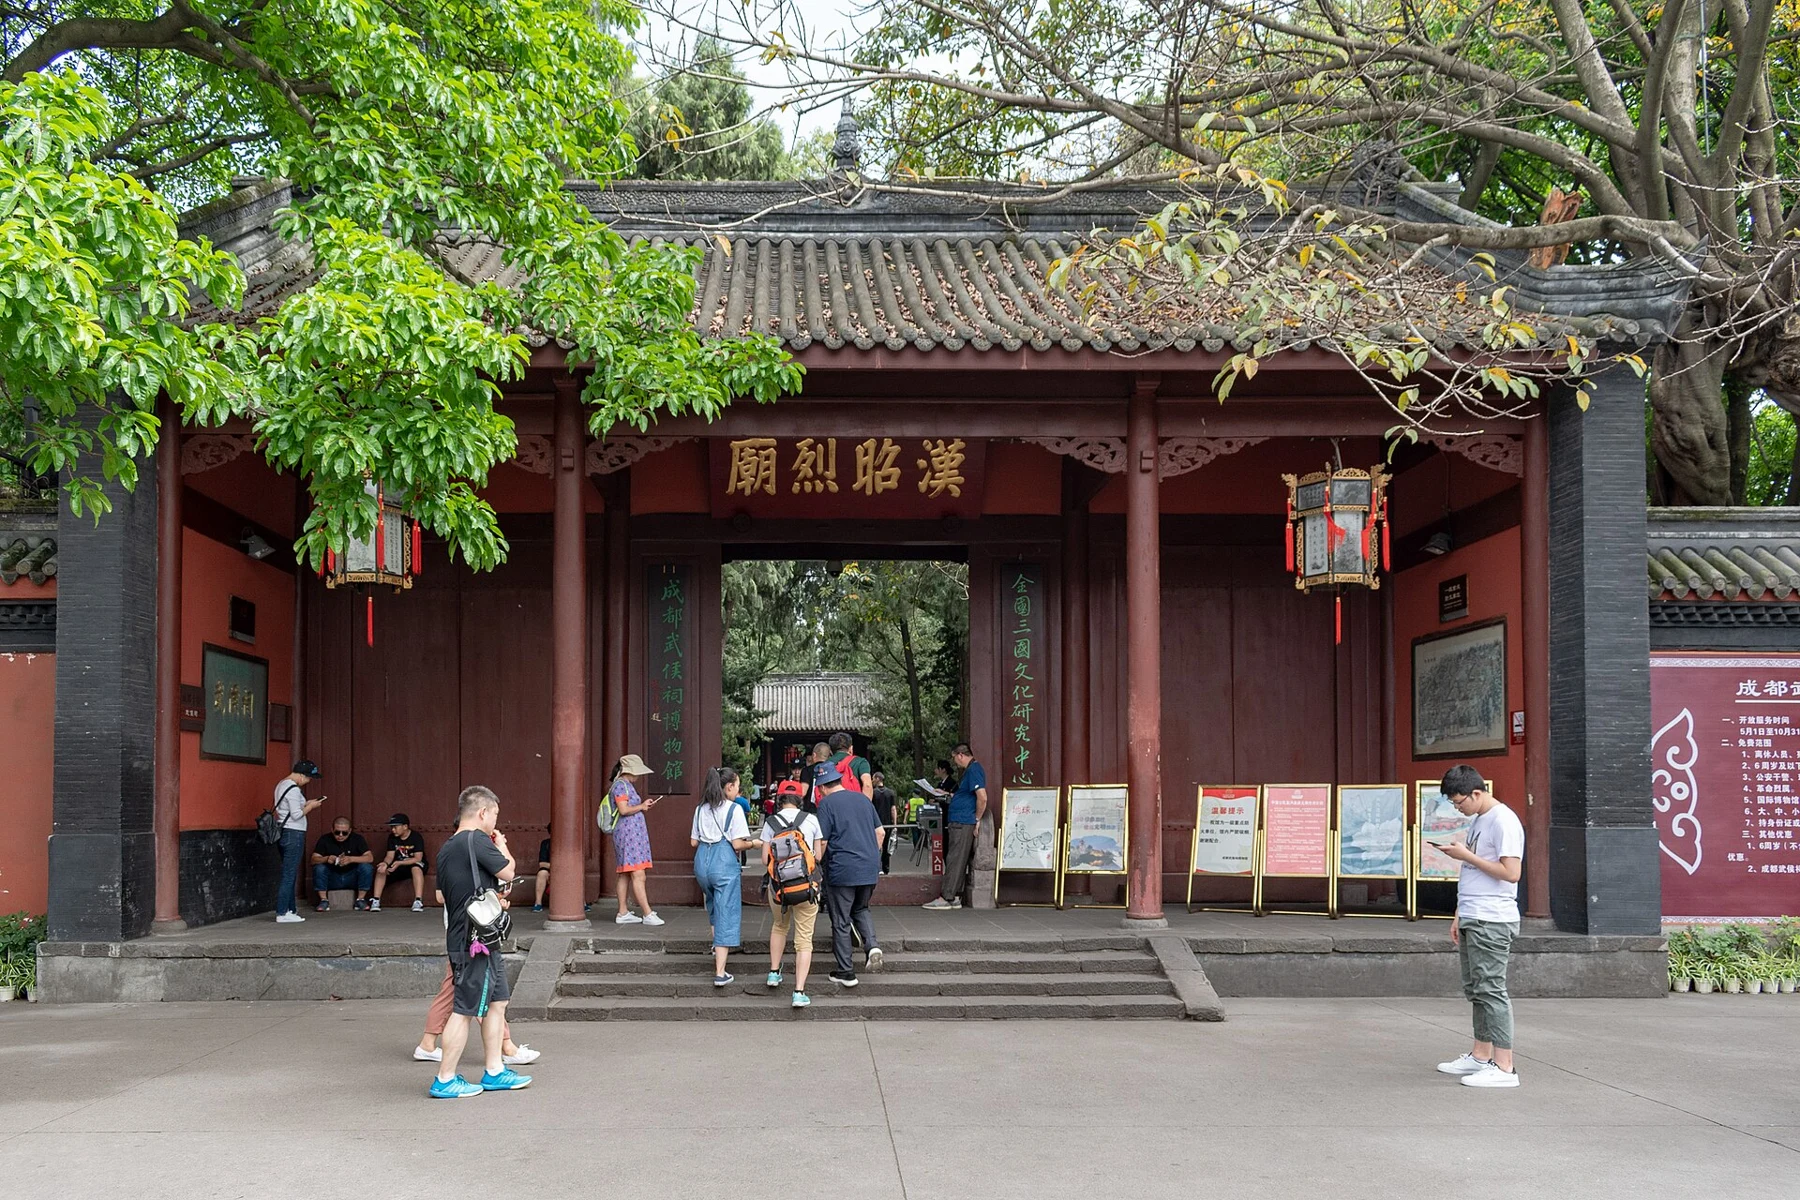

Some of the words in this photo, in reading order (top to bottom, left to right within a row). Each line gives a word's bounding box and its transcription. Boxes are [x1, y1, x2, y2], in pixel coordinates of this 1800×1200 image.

[725, 437, 967, 498] 漢昭烈廟
[1721, 715, 1790, 725] 一、开放服务时间
[1721, 739, 1772, 748] 二、免费范围
[1211, 806, 1245, 815] 温馨提示
[1747, 841, 1800, 851] 1、6周岁（不
[933, 855, 942, 872] 入口
